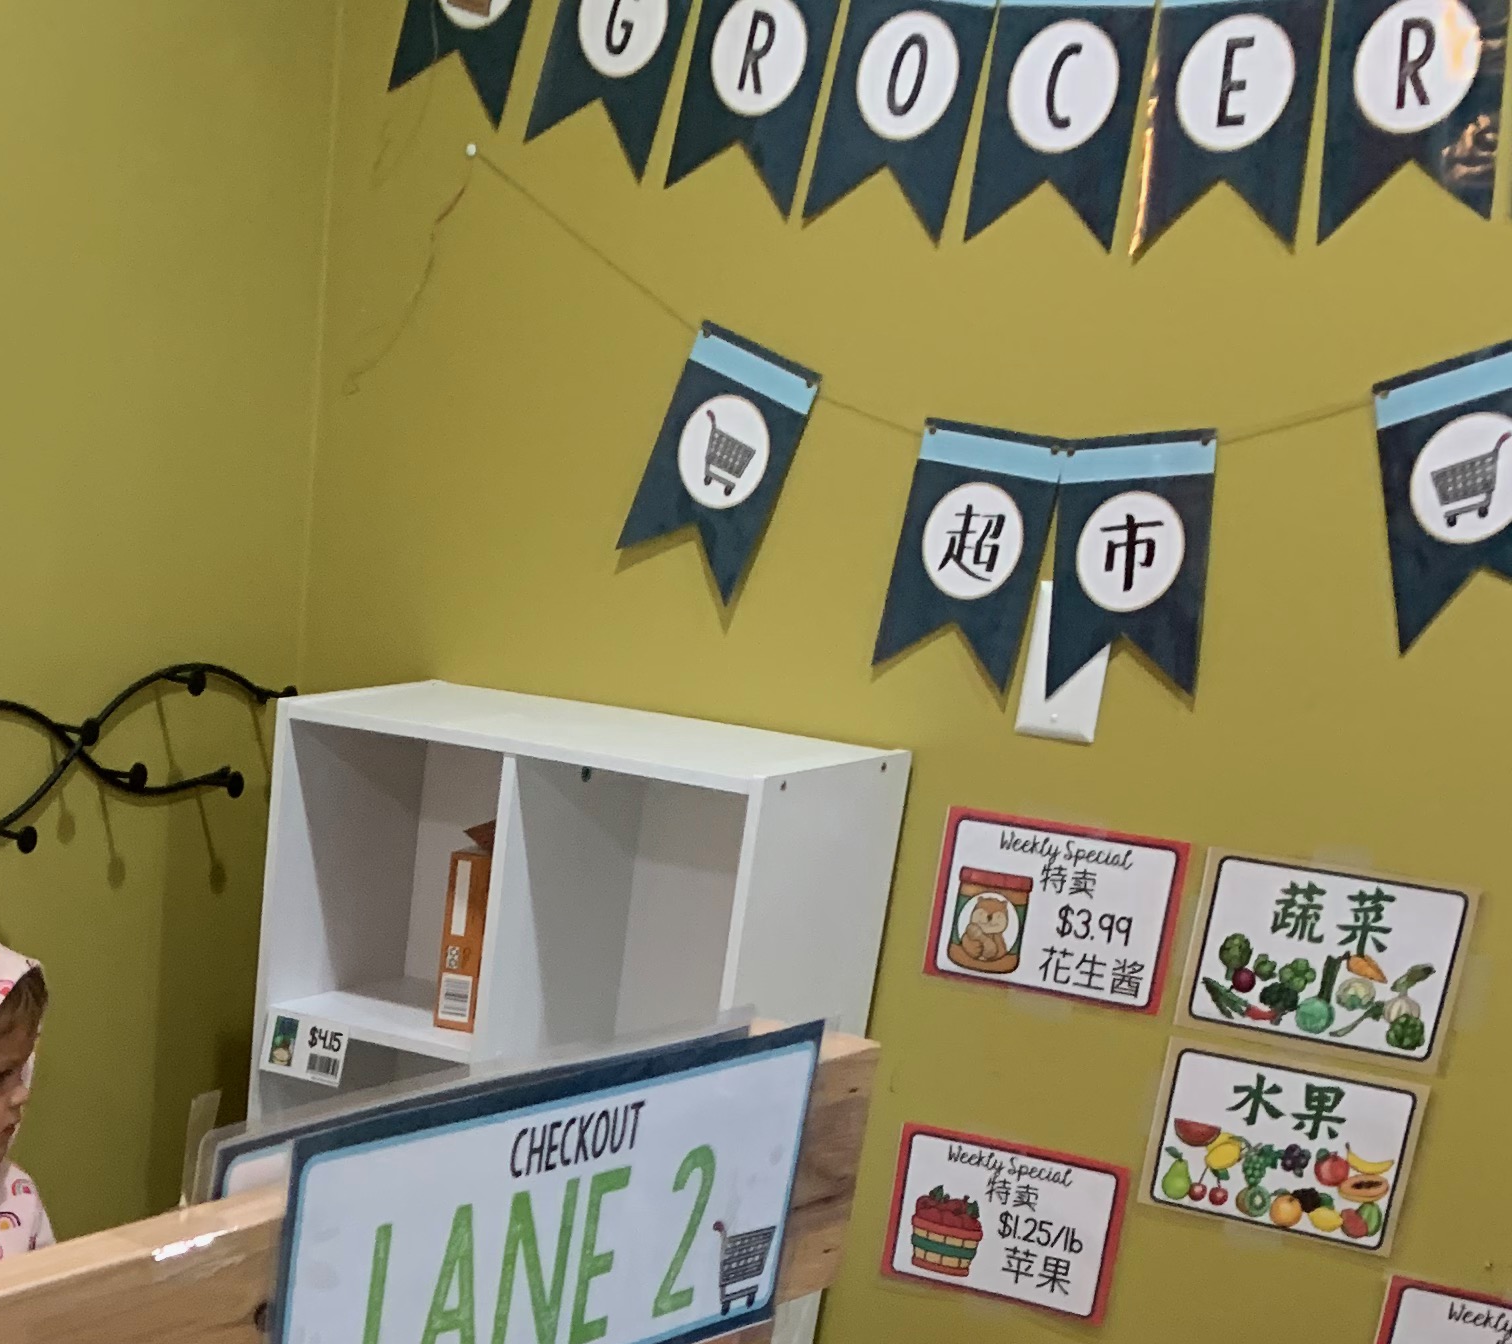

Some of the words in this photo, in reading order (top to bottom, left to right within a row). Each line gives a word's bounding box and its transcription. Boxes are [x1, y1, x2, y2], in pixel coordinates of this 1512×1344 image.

[938, 503, 1165, 592] 超市
[1000, 830, 1060, 864] Weekly
[1064, 840, 1134, 871] Special
[1039, 863, 1098, 899] 特卖
[1056, 904, 1133, 947] $3.99
[1271, 881, 1396, 956] 蔬菜
[1039, 945, 1145, 998] 花生酱
[1226, 1072, 1346, 1140] 水果
[510, 1100, 646, 1178] CHECKOUT
[948, 1144, 1004, 1176] Weekly
[1008, 1157, 1074, 1187] Special
[985, 1175, 1039, 1212] 特卖
[651, 1143, 717, 1319] 2
[998, 1211, 1083, 1255] $1.25/lb
[1002, 1246, 1071, 1295] 苹果
